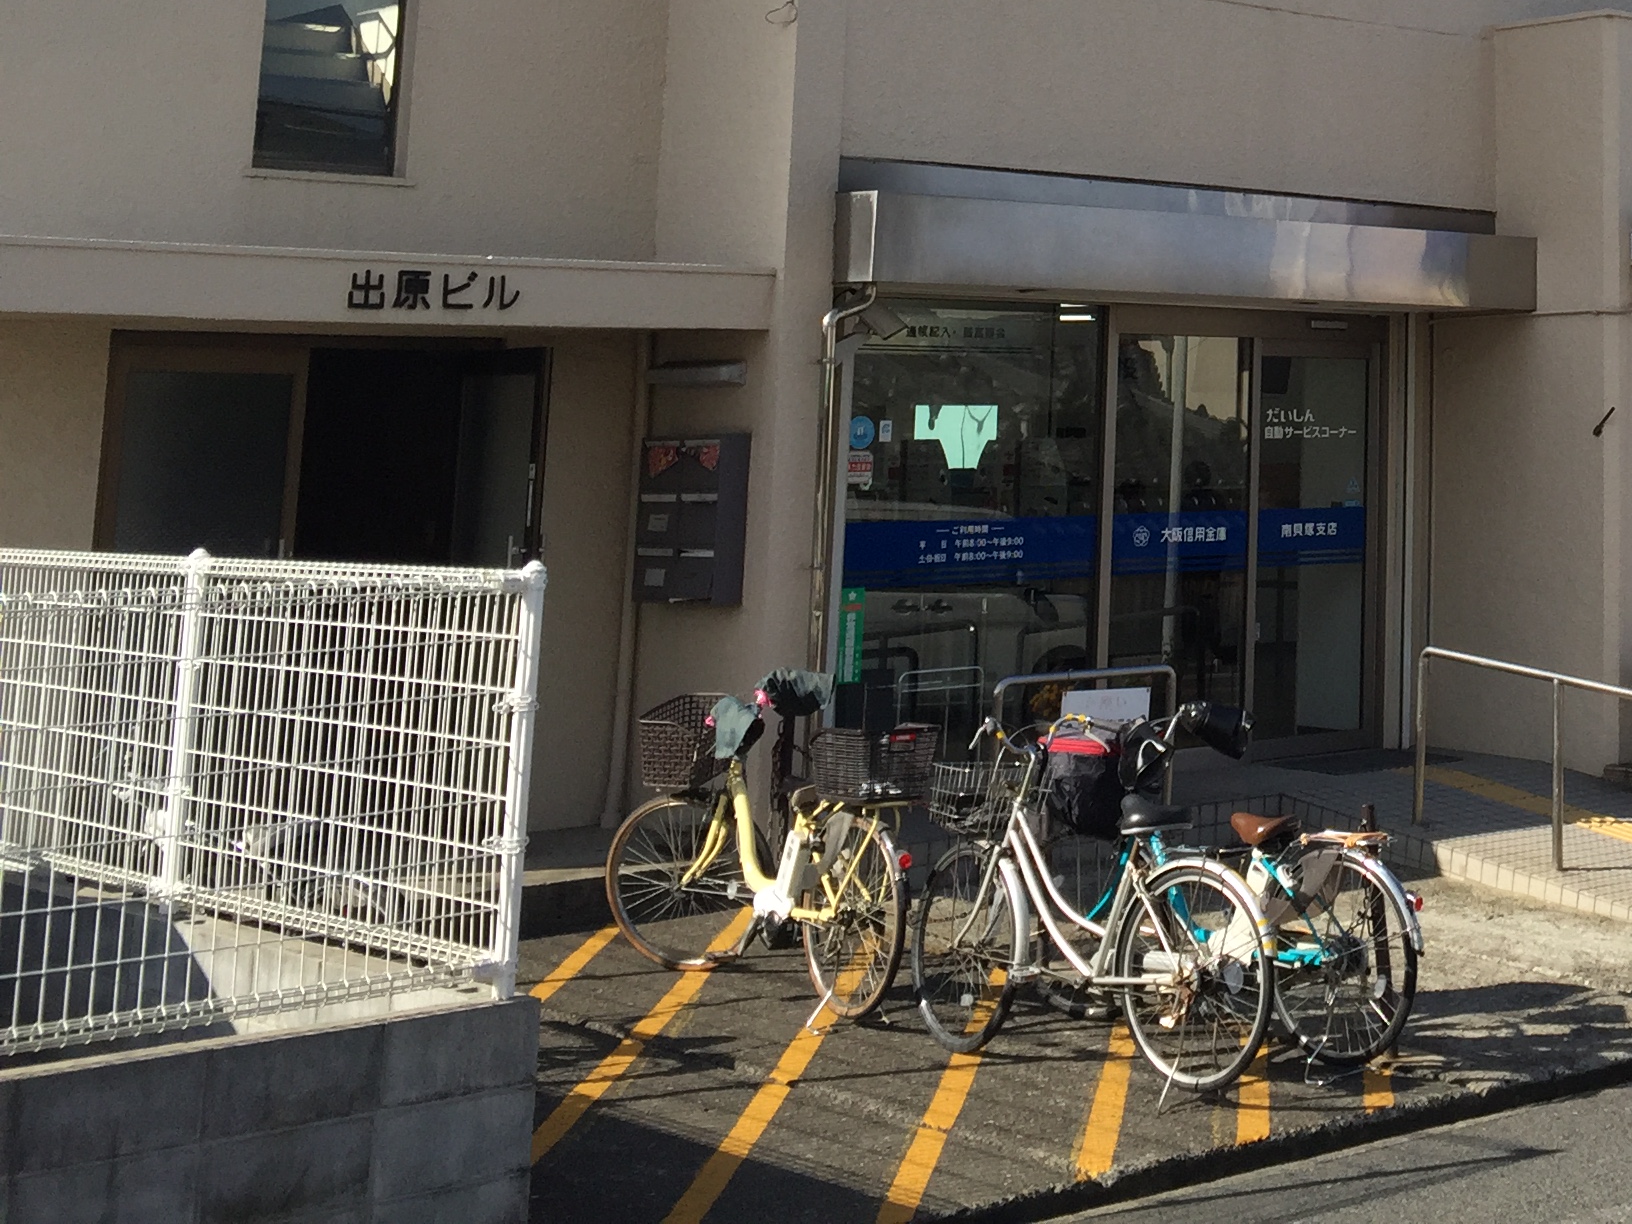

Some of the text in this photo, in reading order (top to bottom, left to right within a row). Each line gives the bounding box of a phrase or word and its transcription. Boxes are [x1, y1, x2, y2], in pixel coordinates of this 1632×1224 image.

[346, 269, 520, 310] 出原ビル
[1266, 408, 1315, 422] だいしん
[1264, 425, 1357, 439] 自動サービスコーナー
[1160, 527, 1227, 543] 大阪信用金庫
[1281, 522, 1338, 538] 南貝塚支店
